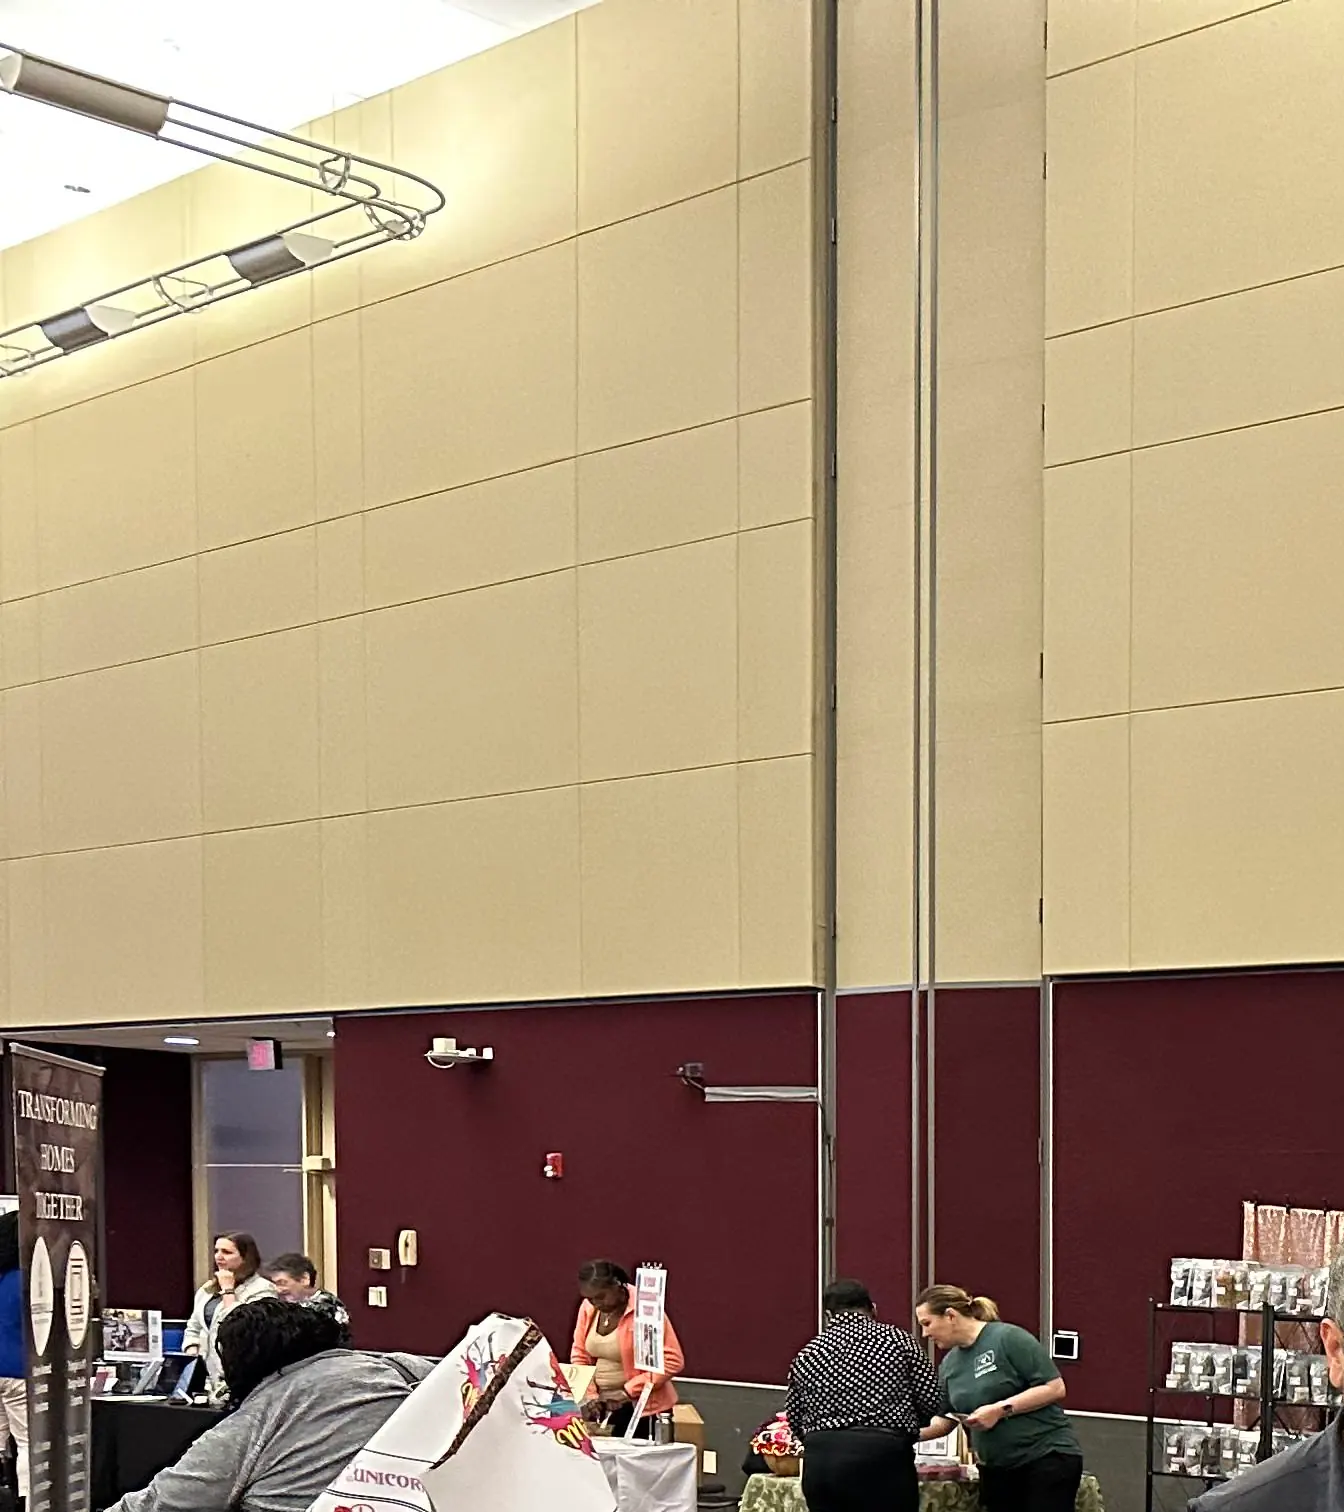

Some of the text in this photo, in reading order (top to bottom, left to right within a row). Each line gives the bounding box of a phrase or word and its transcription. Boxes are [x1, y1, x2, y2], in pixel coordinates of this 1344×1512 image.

[18, 1090, 98, 1130] TRANSFORMING
[40, 1143, 75, 1173] HOMES
[35, 1191, 84, 1221] TOGETHER
[354, 1468, 425, 1493] UNICOR
